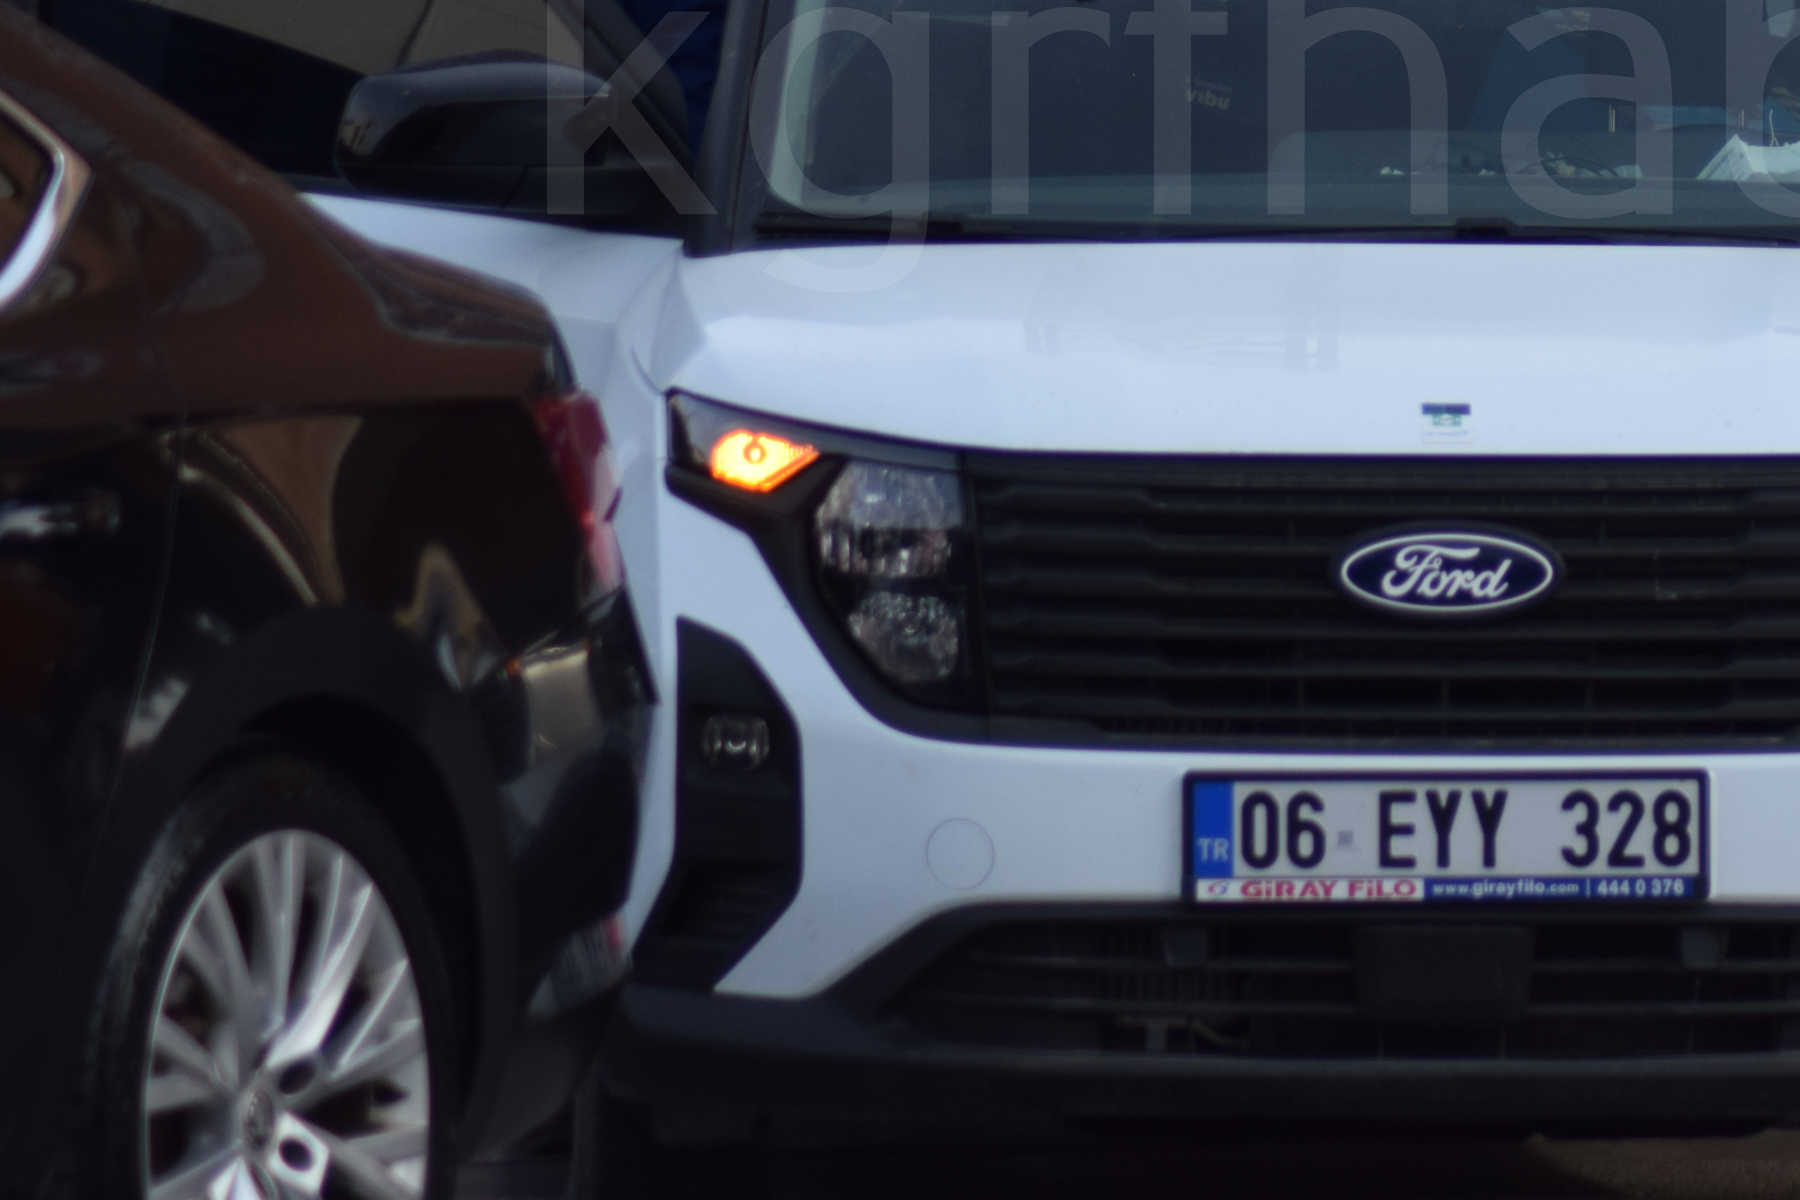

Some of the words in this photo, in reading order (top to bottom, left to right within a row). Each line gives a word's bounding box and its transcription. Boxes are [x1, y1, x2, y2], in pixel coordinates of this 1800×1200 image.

[1382, 544, 1511, 599] Ford
[1241, 790, 1326, 870] 06
[1378, 790, 1508, 869] EYY
[1560, 789, 1693, 869] 328
[1199, 838, 1230, 862] TR
[1432, 877, 1580, 897] www.girayfilo.com
[1597, 878, 1633, 896] 444
[1652, 878, 1685, 896] 376
